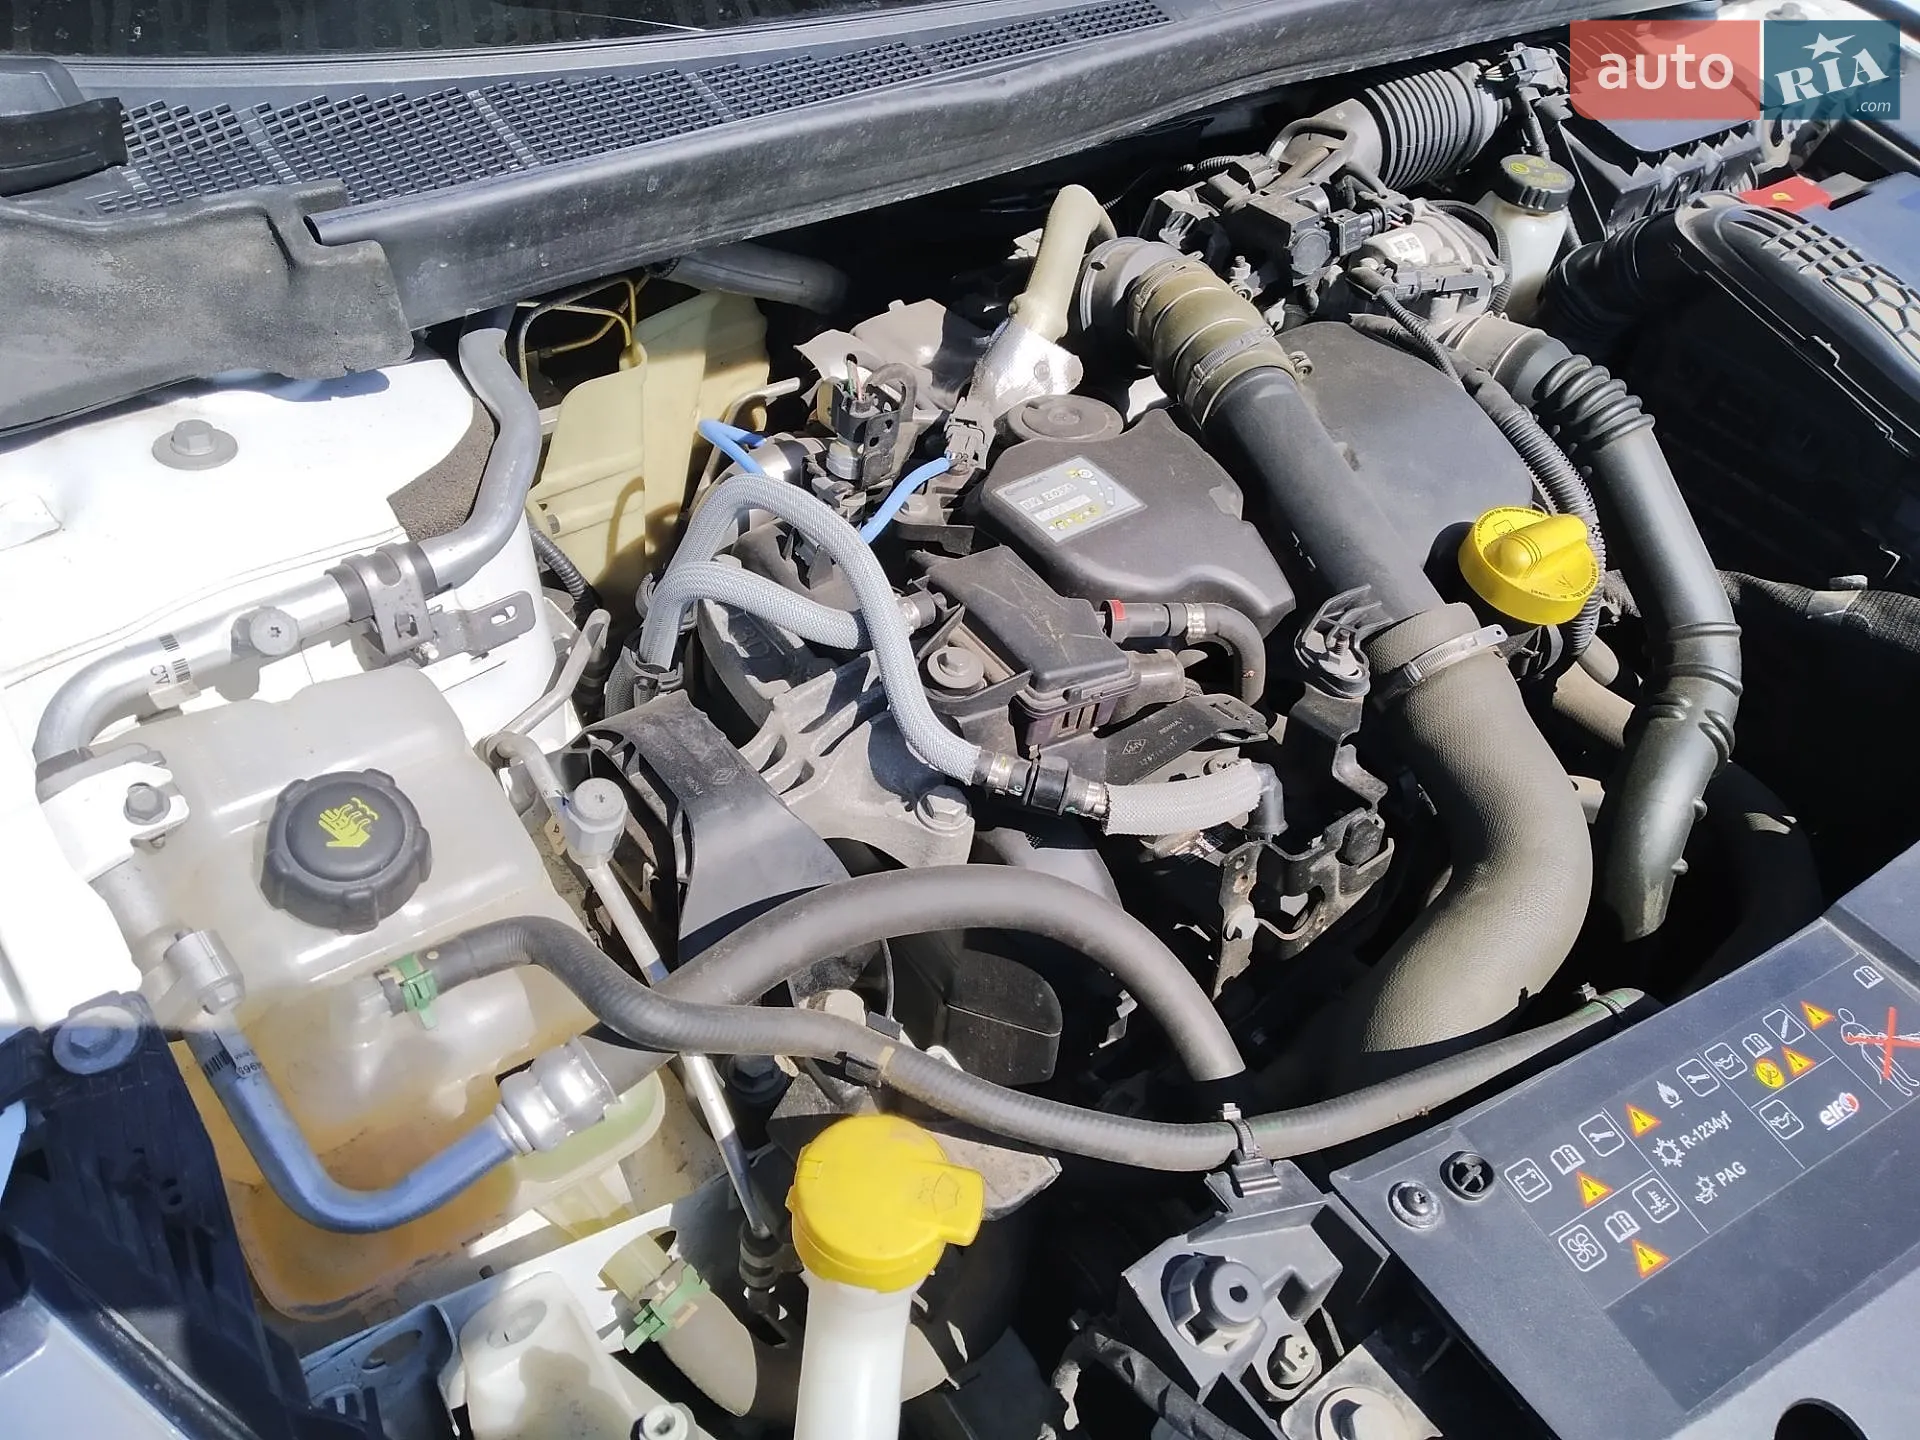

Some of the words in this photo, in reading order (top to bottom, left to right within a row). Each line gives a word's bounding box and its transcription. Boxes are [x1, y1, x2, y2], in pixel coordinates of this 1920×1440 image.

[1819, 1095, 1850, 1127] elf
[1679, 1110, 1732, 1149] R-1234yf
[1714, 1161, 1747, 1187] PAG
